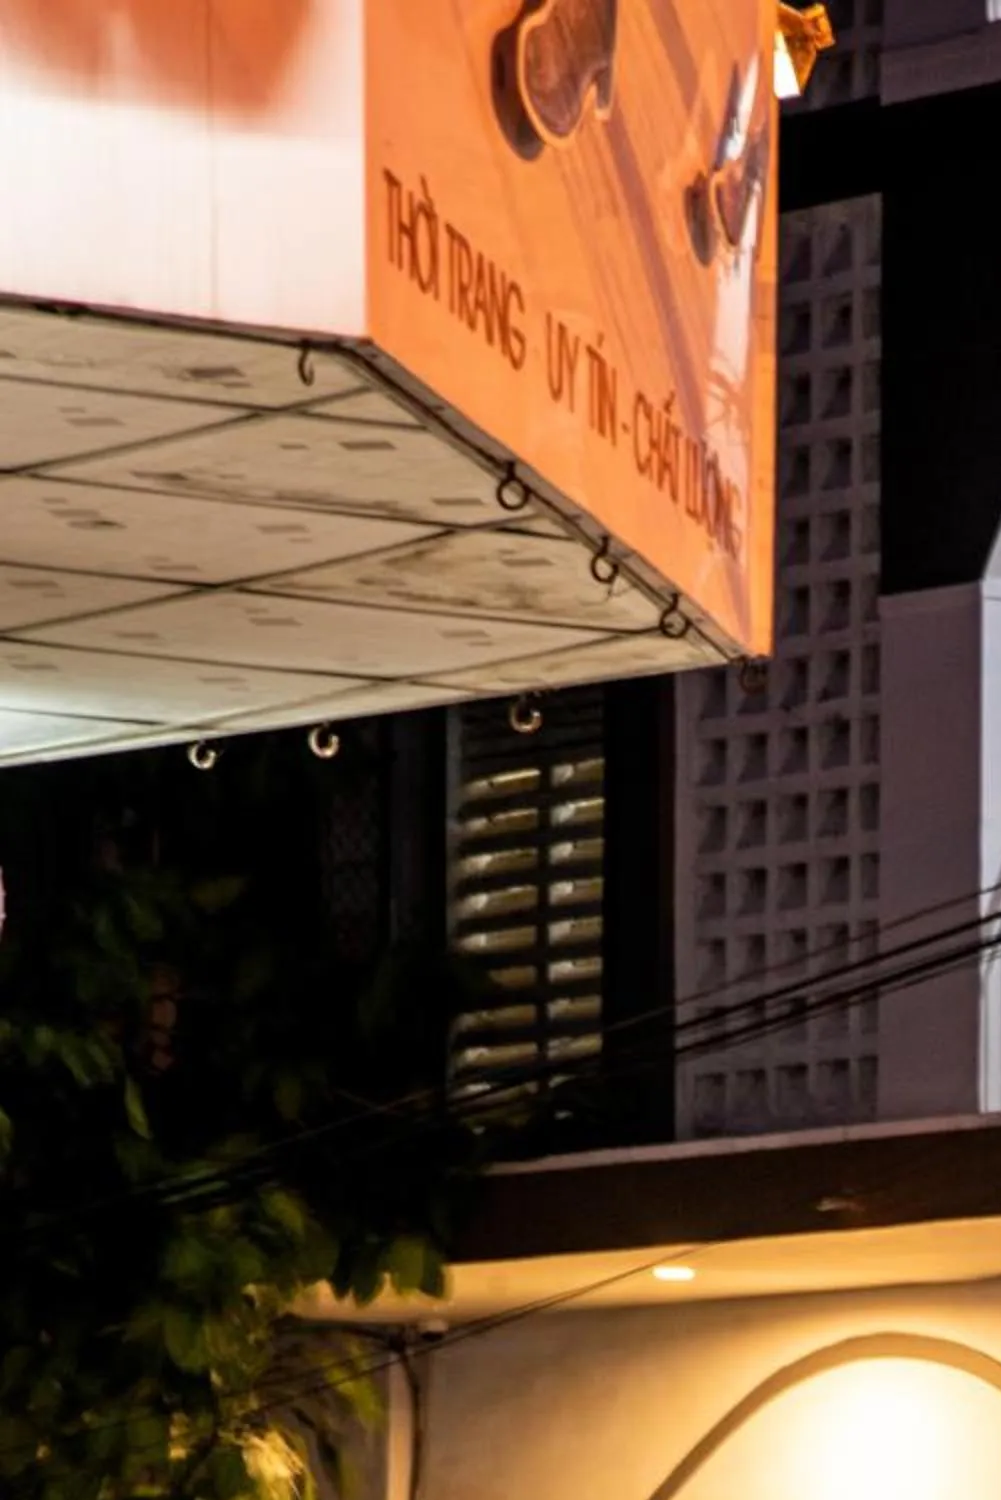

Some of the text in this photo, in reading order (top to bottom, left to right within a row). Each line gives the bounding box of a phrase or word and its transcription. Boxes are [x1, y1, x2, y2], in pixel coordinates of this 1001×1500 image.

[384, 168, 439, 301] THỜI
[446, 223, 526, 371] TRANG
[545, 312, 580, 413] UY
[586, 332, 617, 447] TÍN
